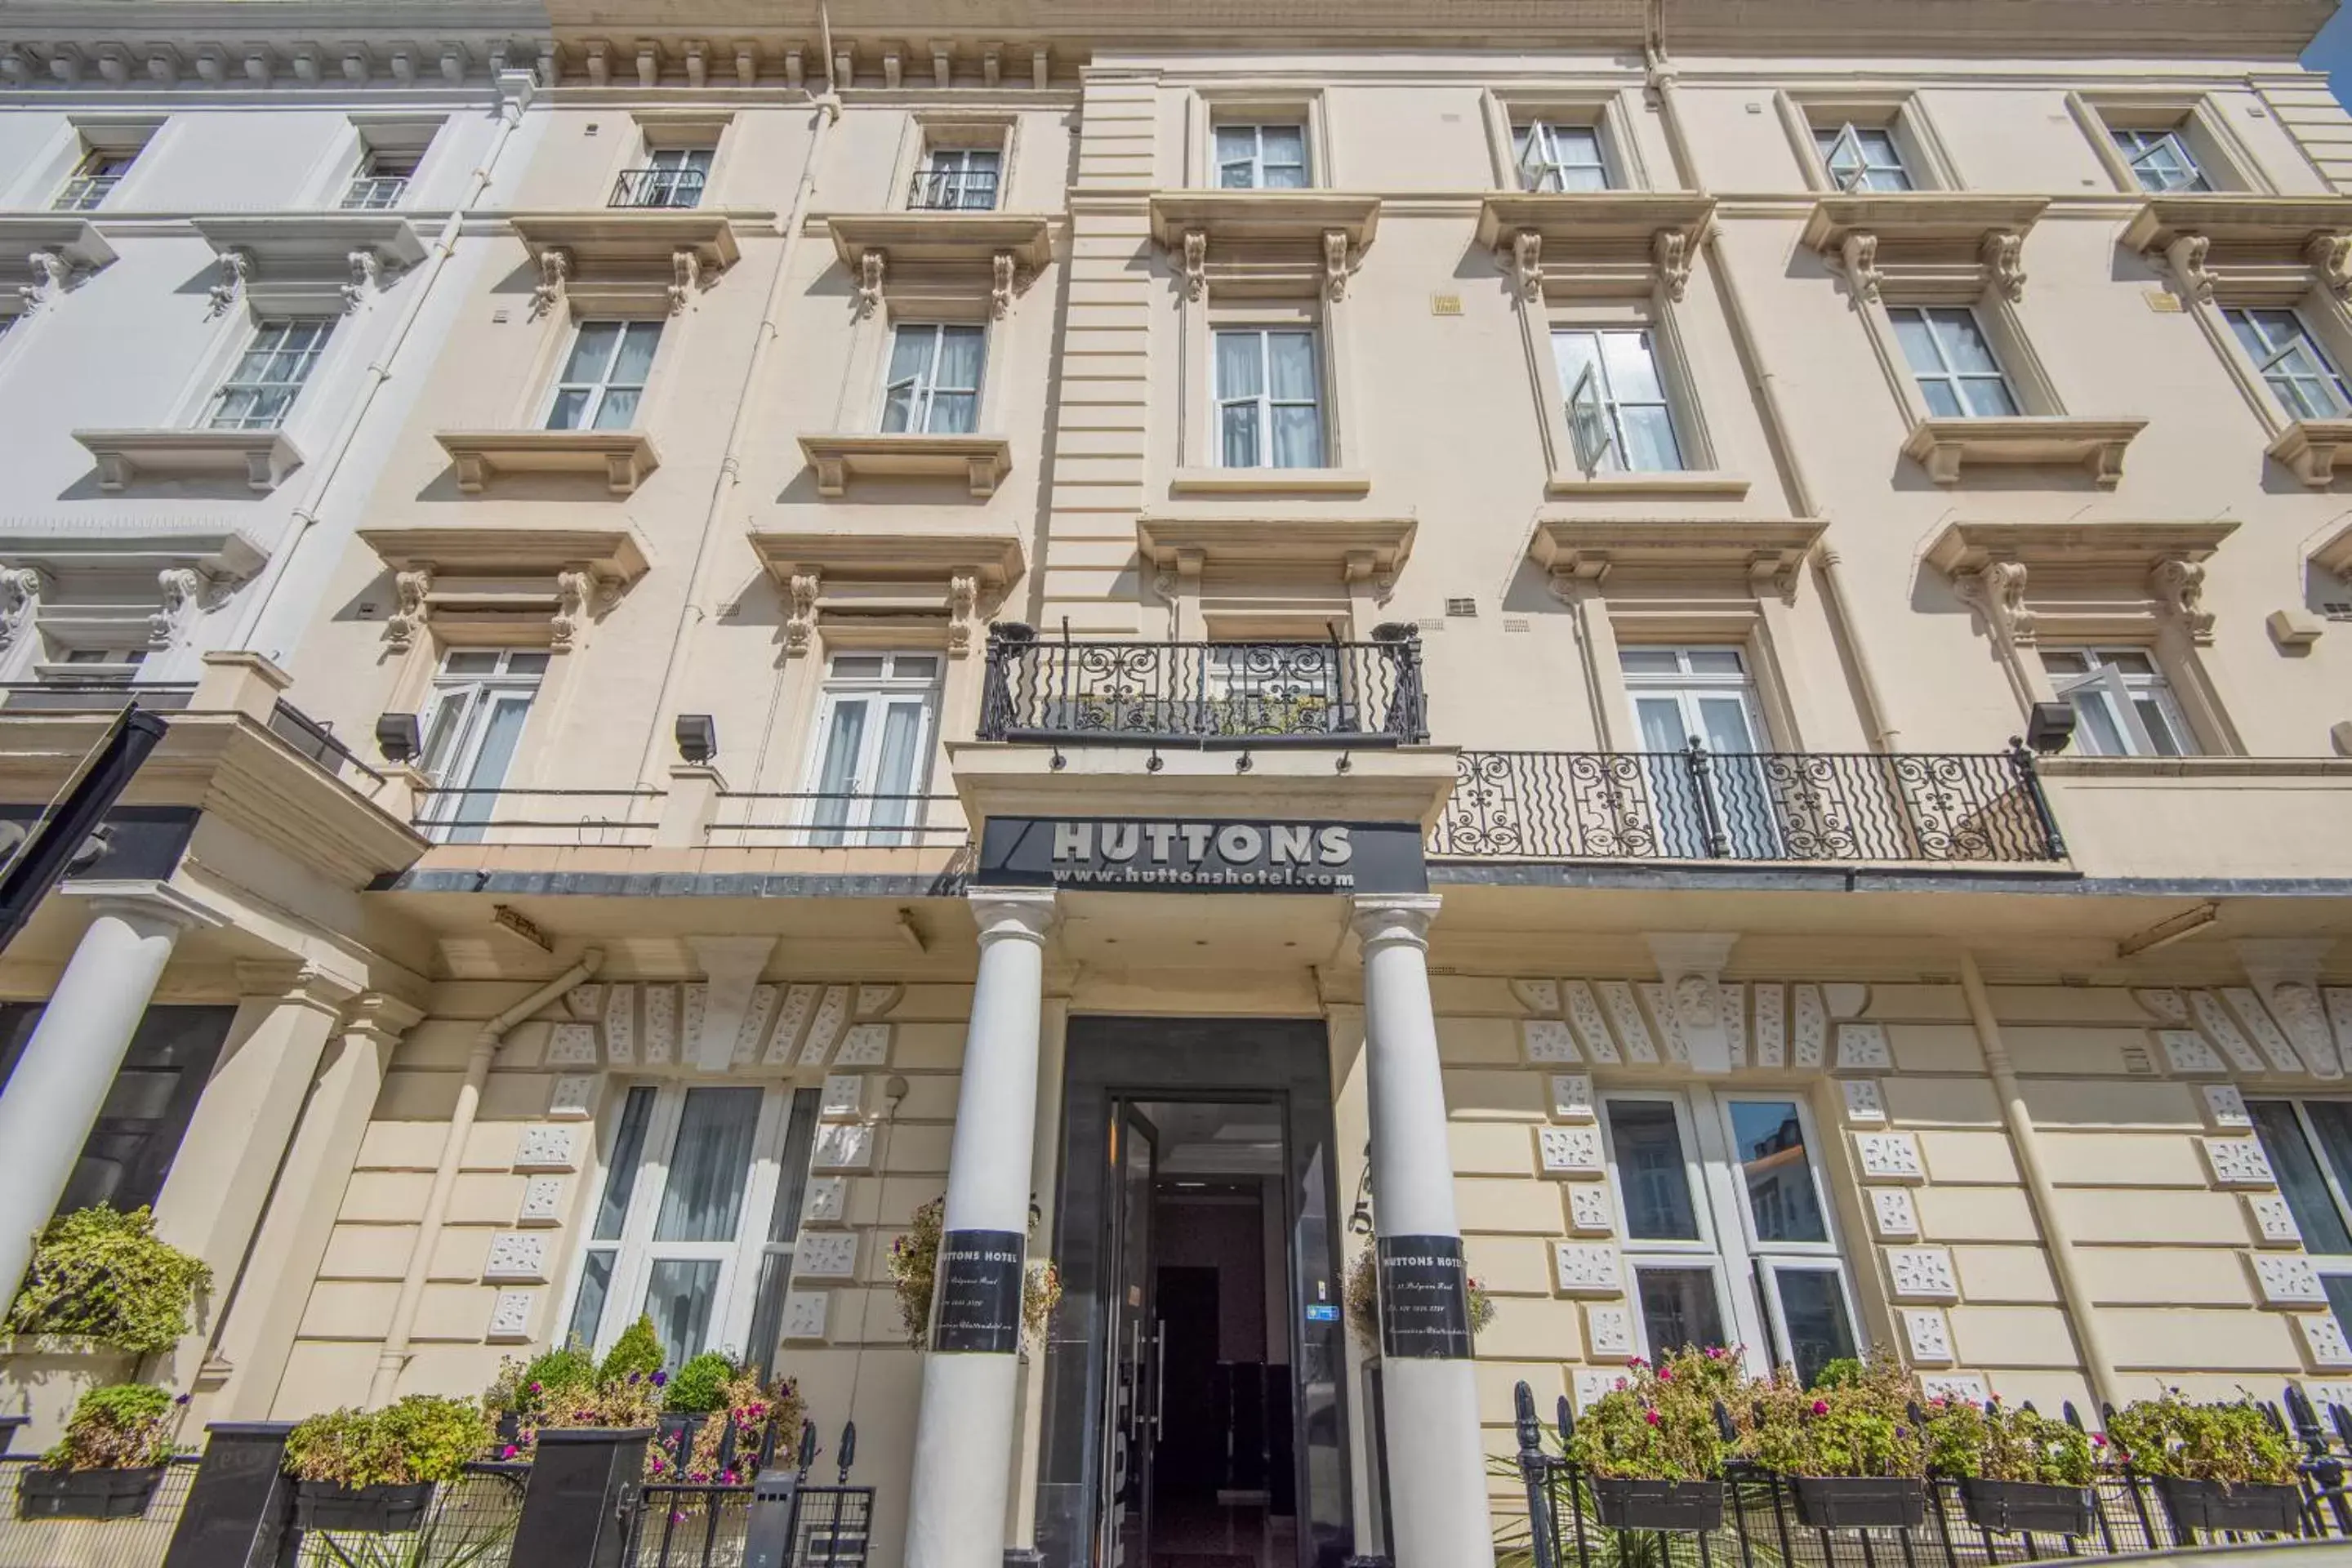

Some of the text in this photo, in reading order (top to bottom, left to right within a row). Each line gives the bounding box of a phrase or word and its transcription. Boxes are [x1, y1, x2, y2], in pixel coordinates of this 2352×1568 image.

[1053, 822, 1352, 864] HUTTONS
[1054, 866, 1355, 888] www.huttonshotel.com
[984, 1250, 1017, 1263] HOTEL
